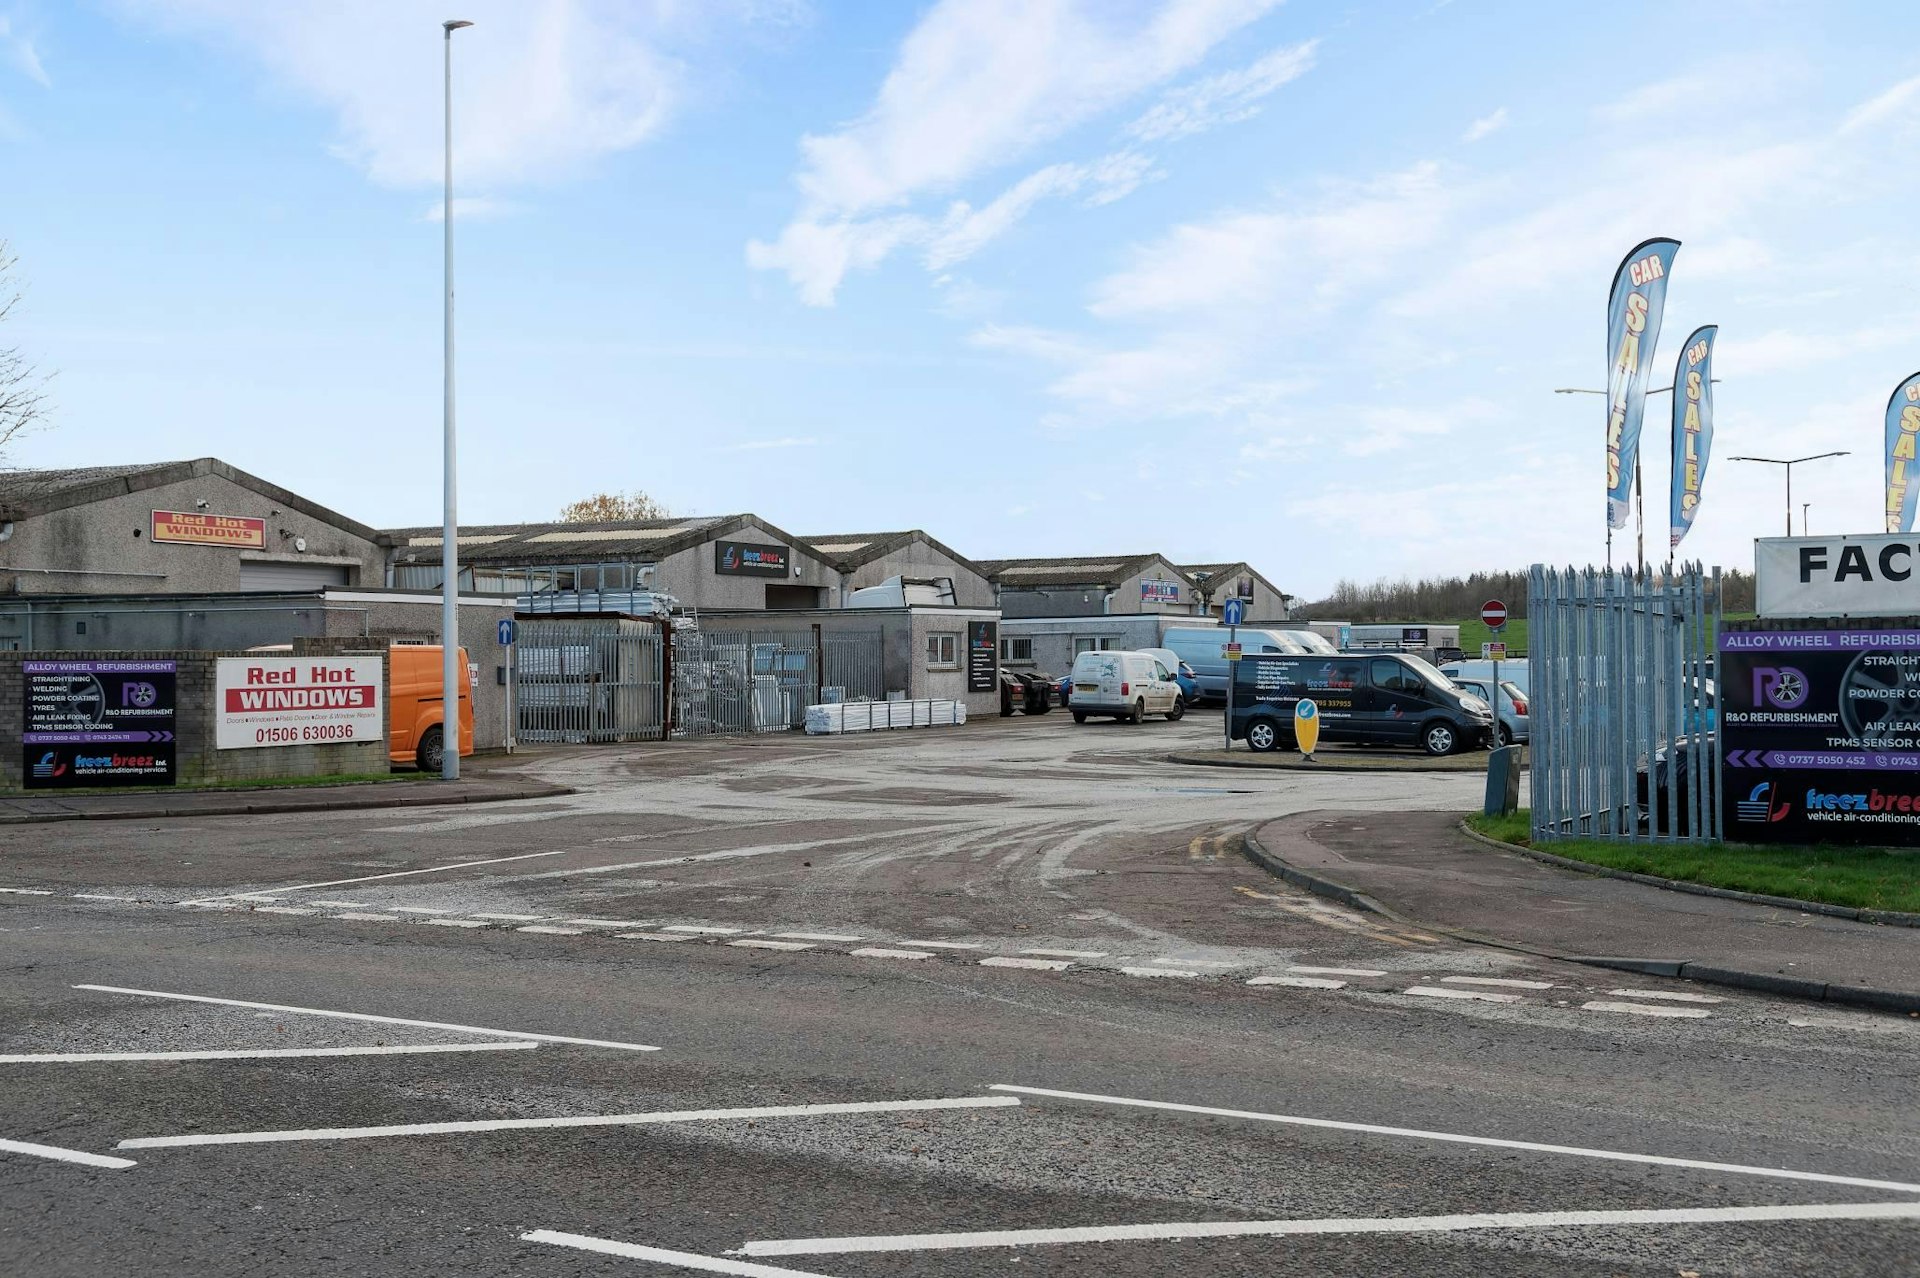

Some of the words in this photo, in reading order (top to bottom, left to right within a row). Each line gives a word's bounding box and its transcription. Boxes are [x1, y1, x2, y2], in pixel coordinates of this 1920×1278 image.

[1629, 254, 1664, 287] CAR
[1687, 339, 1708, 367] CAR
[171, 514, 206, 525] Red
[215, 517, 247, 529] Hot
[166, 525, 253, 539] WINDOWS
[1800, 543, 1920, 583] FAC
[1726, 636, 1773, 647] ALLOY
[1777, 636, 1832, 647] WHEEL
[28, 663, 57, 671] ALLOY
[59, 663, 92, 671] WHEEL
[96, 663, 172, 671] REFURBISHMENT
[247, 667, 296, 685] Red
[312, 666, 355, 683] Hot
[1905, 672, 1920, 682] W
[240, 688, 364, 709] WINDOWS
[1849, 689, 1905, 698] POWDER
[1726, 712, 1748, 722] R&O
[1750, 712, 1839, 723] REFURBISHMENT
[1865, 722, 1886, 731] AIR
[1889, 722, 1920, 731] LEAK
[256, 727, 298, 743] 01506
[303, 724, 353, 740] 630036
[1826, 737, 1860, 747] TPMS
[1863, 738, 1914, 748] SENSOR
[75, 753, 154, 767] freezbreez
[1789, 755, 1814, 764] 0737
[1817, 756, 1844, 765] 5050
[1846, 756, 1866, 766] 452
[1891, 757, 1918, 766] 0743
[97, 767, 142, 775] air-conditioning
[1807, 812, 1842, 821] vehicle
